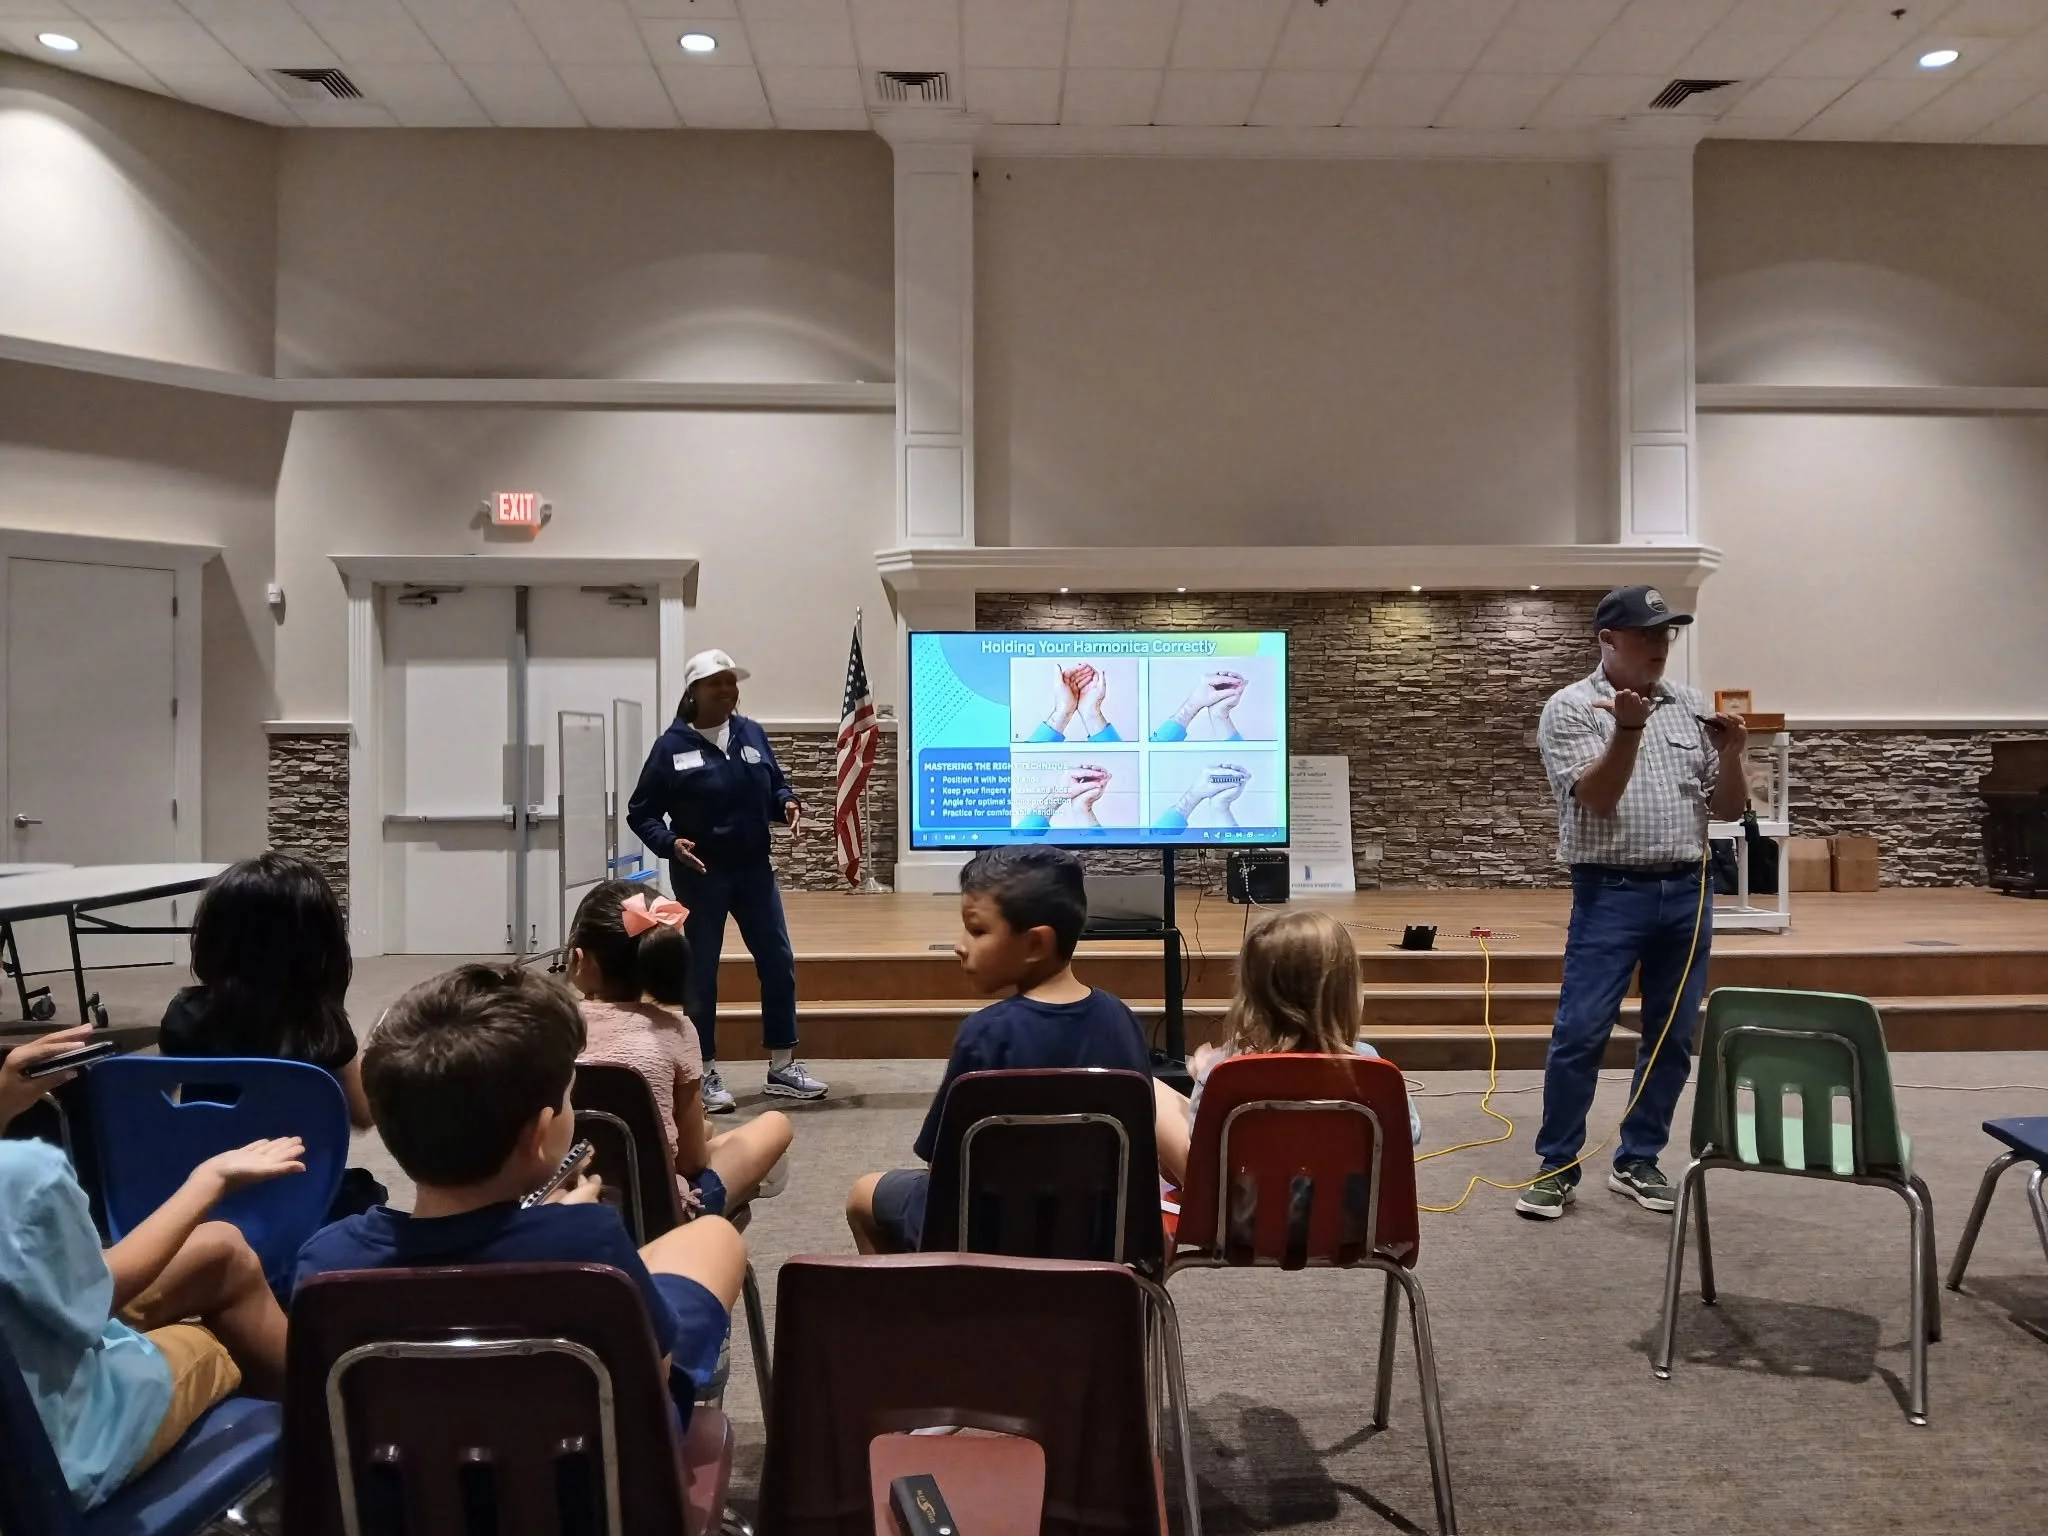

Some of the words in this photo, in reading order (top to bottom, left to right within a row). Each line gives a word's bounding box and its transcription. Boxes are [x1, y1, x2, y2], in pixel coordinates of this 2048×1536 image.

[499, 493, 533, 521] EXIT
[981, 640, 1035, 655] Holding
[1039, 640, 1070, 654] Your
[1073, 640, 1149, 653] Harmonica
[1152, 639, 1217, 655] Correctly
[924, 762, 973, 771] MASTERING
[974, 762, 991, 770] THE
[942, 775, 972, 784] Position
[980, 775, 997, 783] with
[942, 787, 961, 796] Keep
[962, 788, 980, 796] your
[981, 787, 1007, 796] fingers
[942, 798, 964, 808] Angle
[965, 798, 977, 806] for
[978, 797, 1006, 807] optimal
[942, 809, 972, 817] Practice
